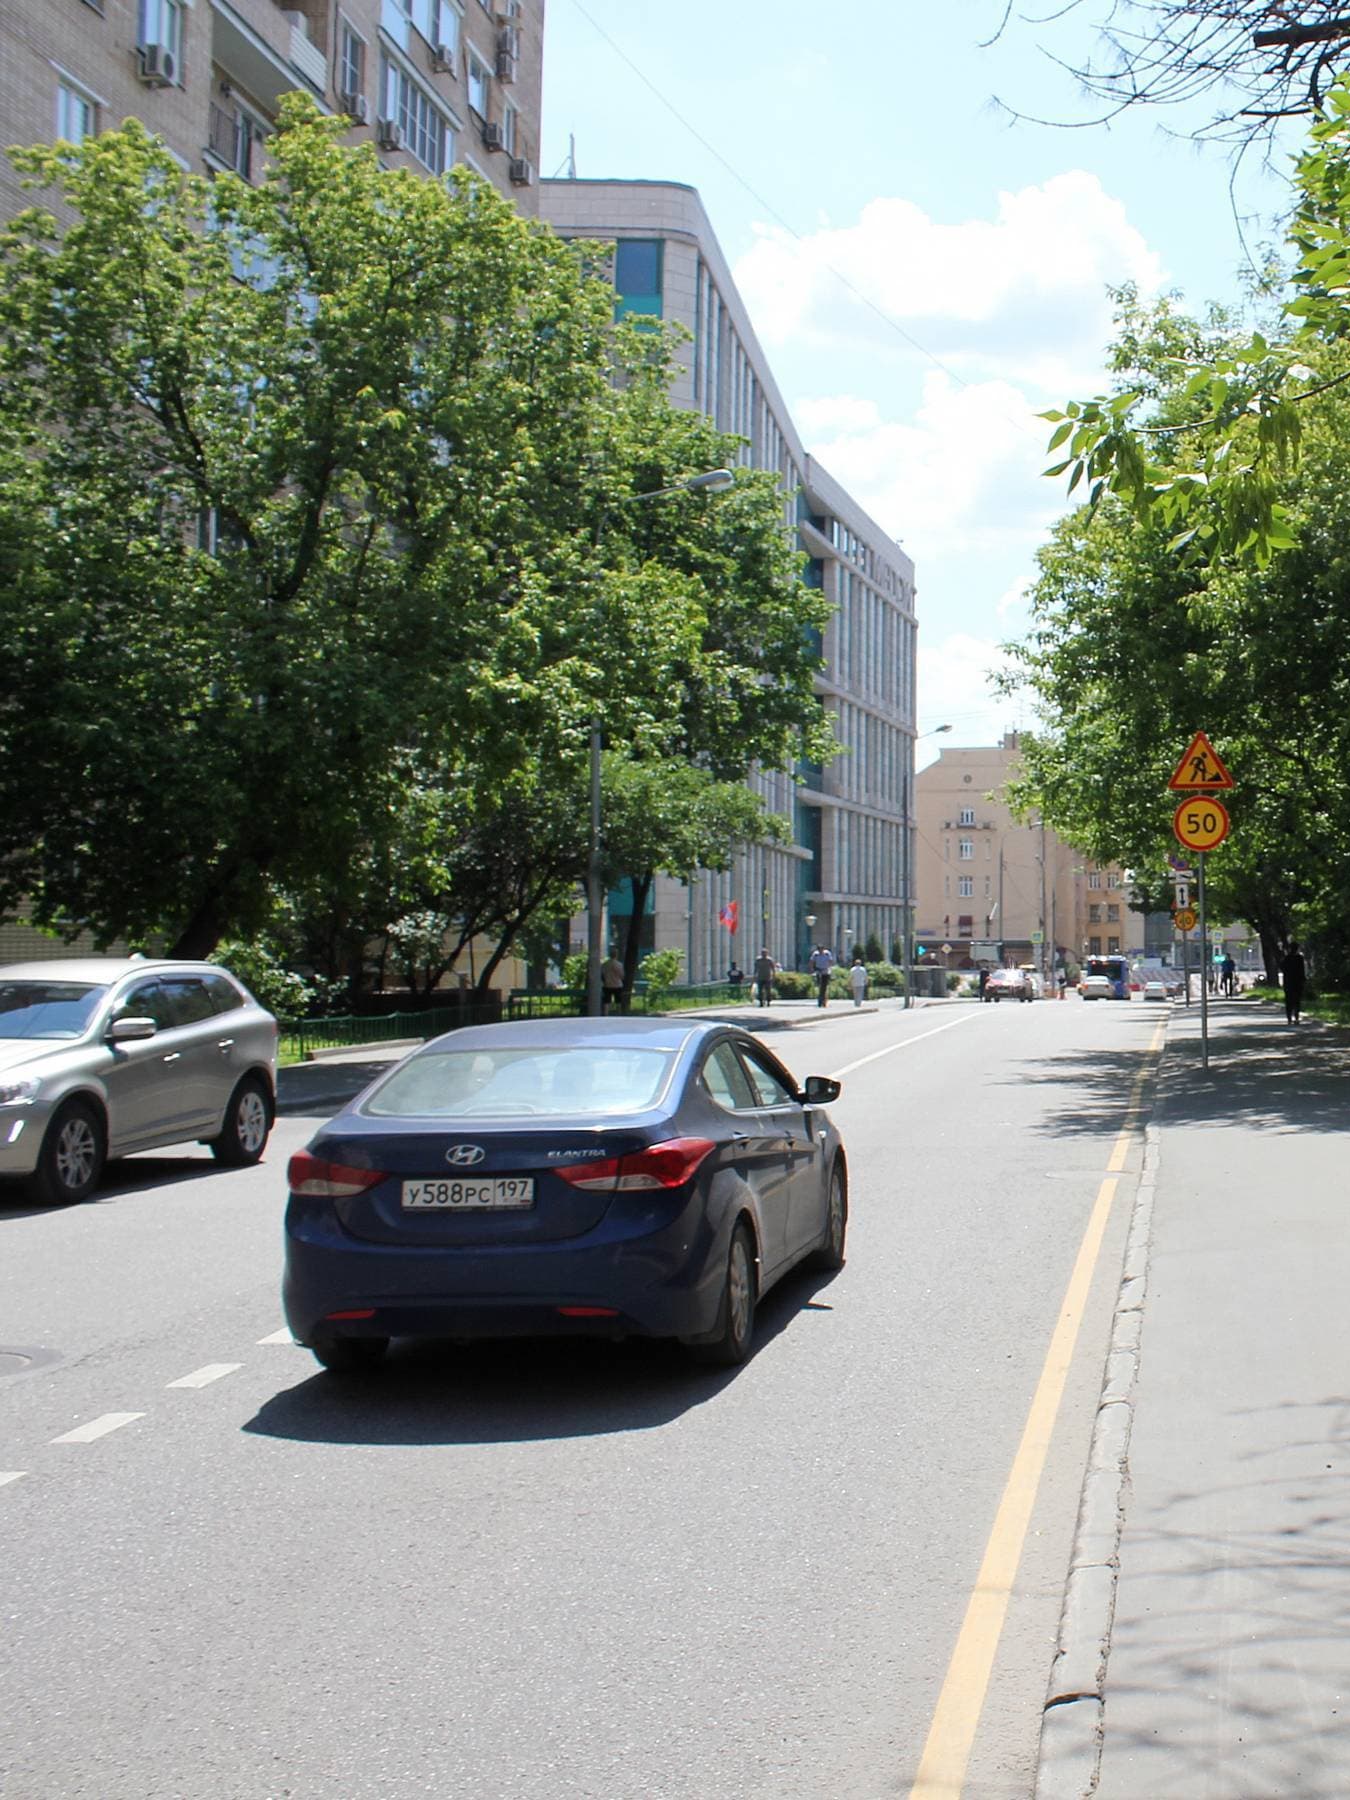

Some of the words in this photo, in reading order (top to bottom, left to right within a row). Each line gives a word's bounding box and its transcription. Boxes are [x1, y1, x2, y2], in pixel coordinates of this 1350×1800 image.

[1186, 813, 1217, 834] 50
[547, 1149, 606, 1158] ELANTRA
[497, 1180, 529, 1197] 197
